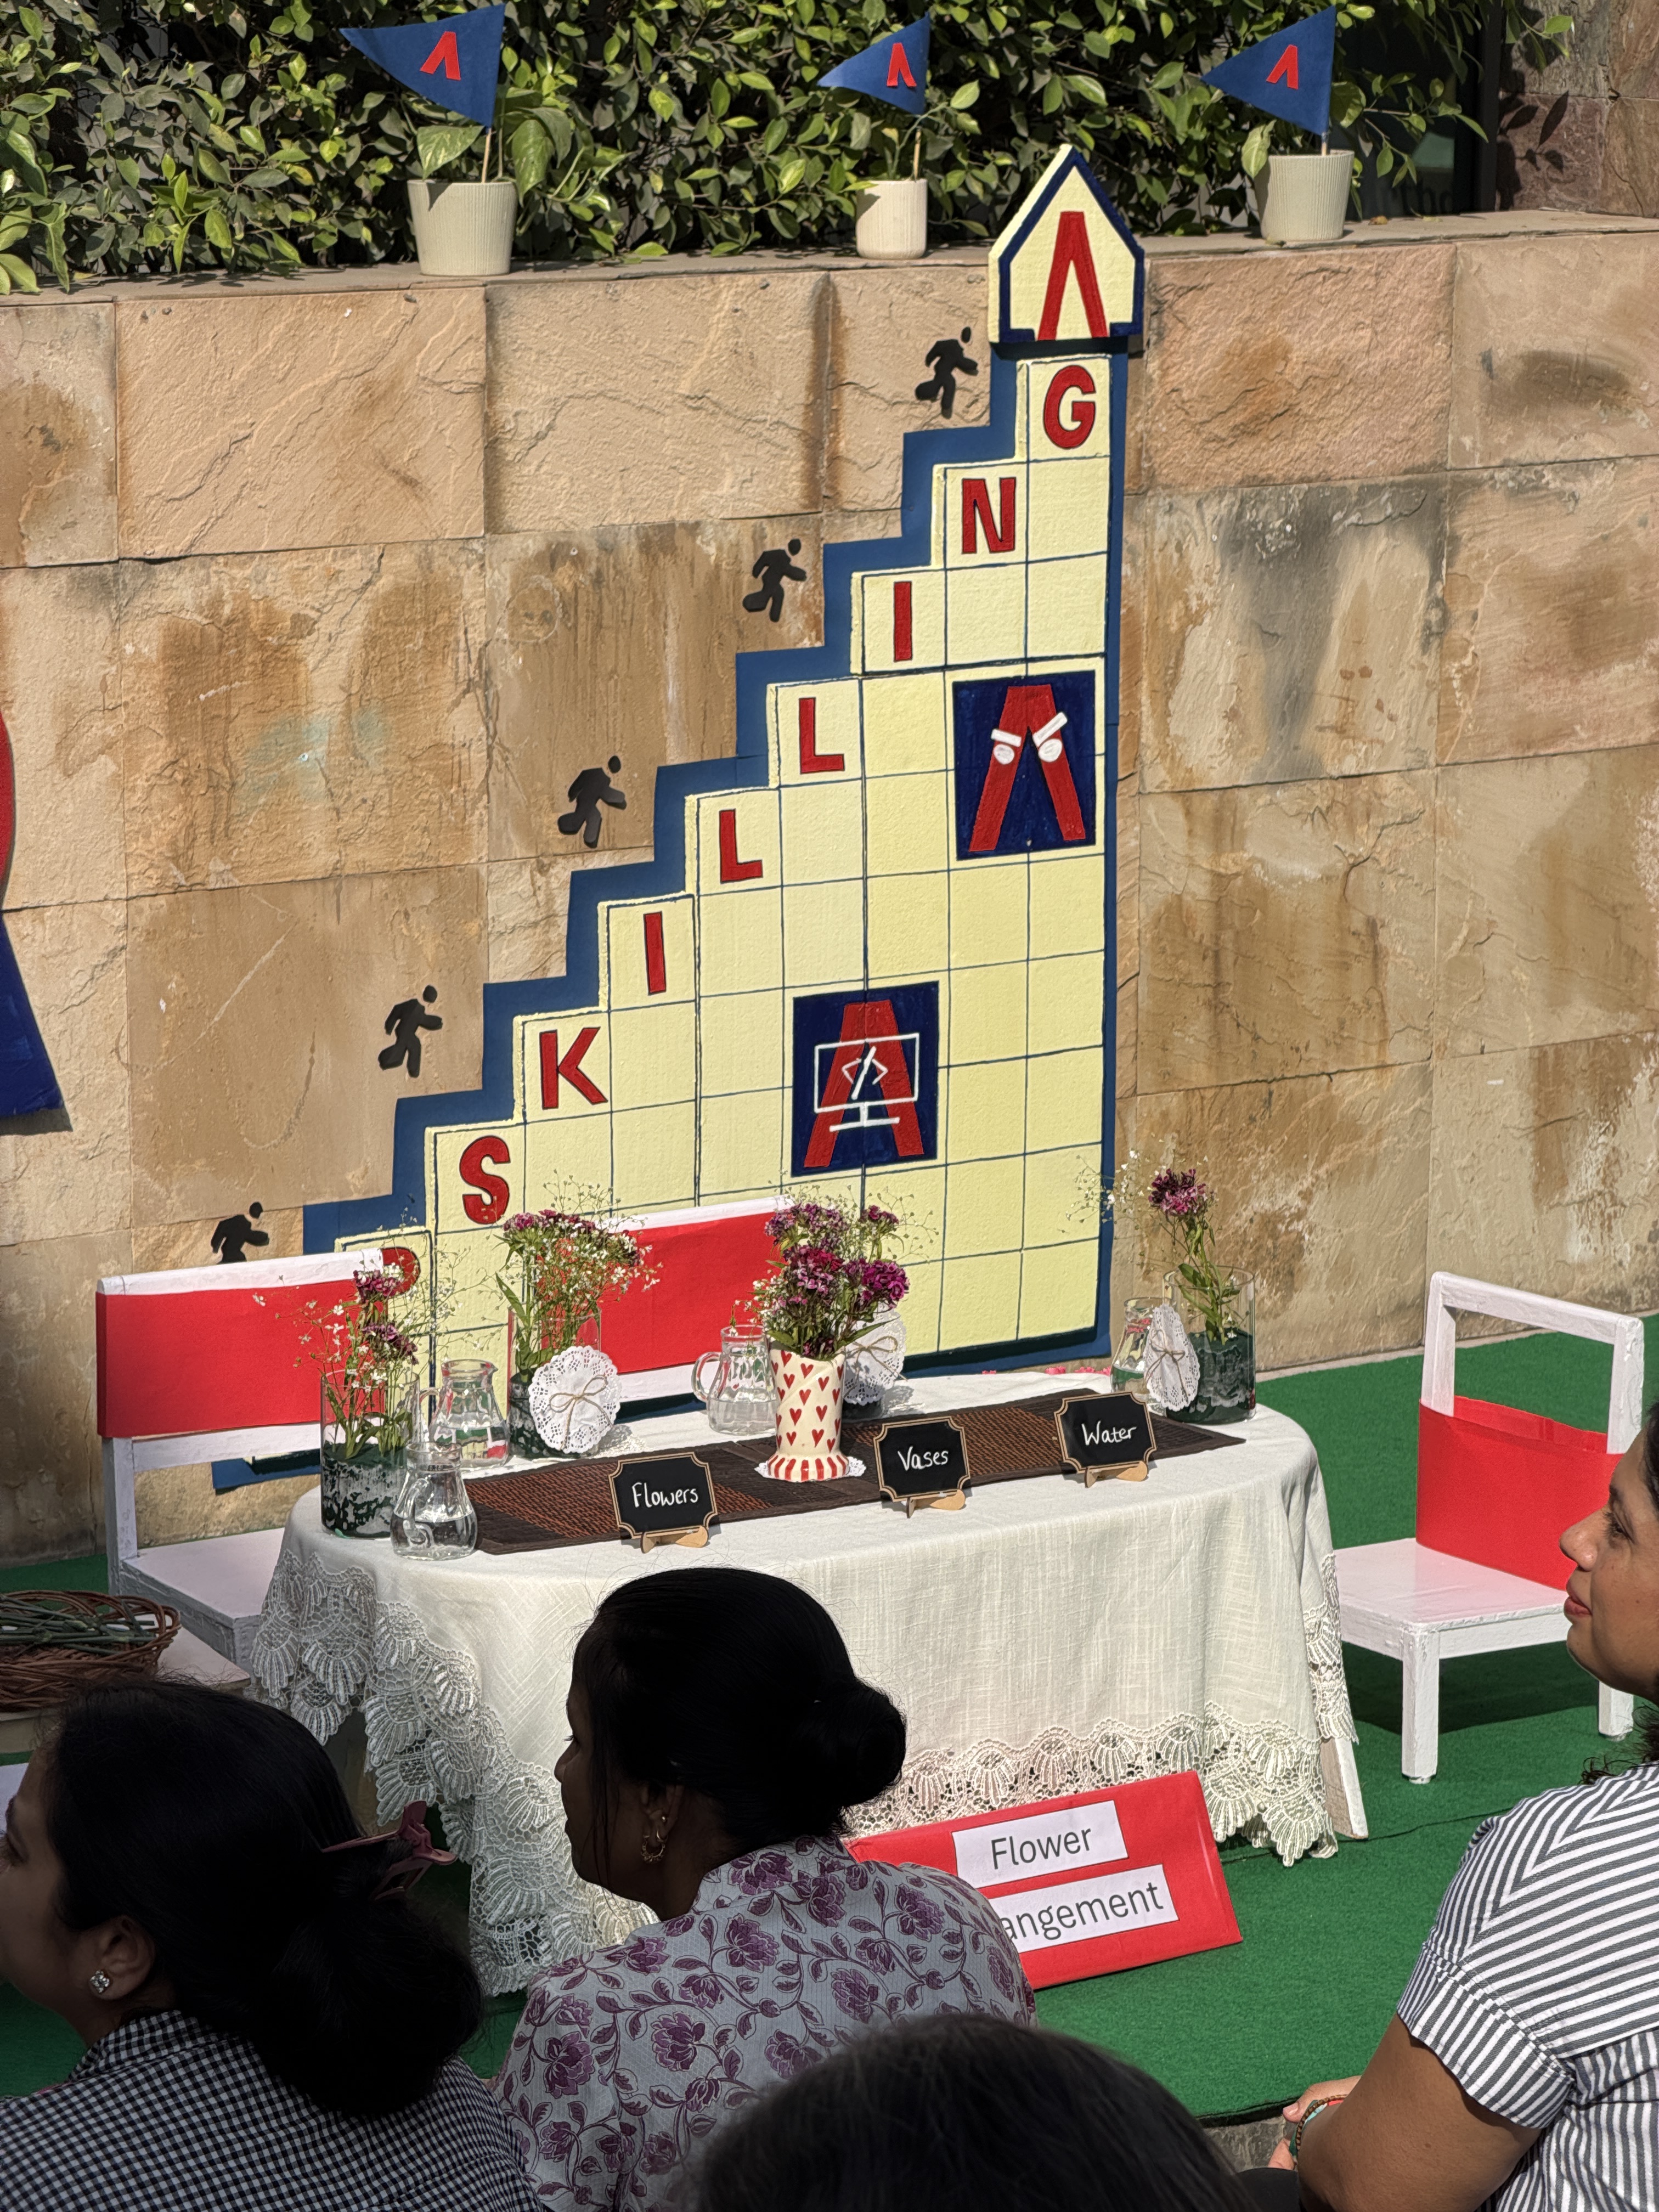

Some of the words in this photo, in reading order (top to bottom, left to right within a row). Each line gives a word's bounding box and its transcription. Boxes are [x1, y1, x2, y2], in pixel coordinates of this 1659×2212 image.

[1081, 1421, 1137, 1447] Water
[898, 1446, 949, 1471] Vases
[631, 1482, 699, 1509] Flowers
[991, 1828, 1091, 1870] Flower
[1000, 1882, 1164, 1941] angement
